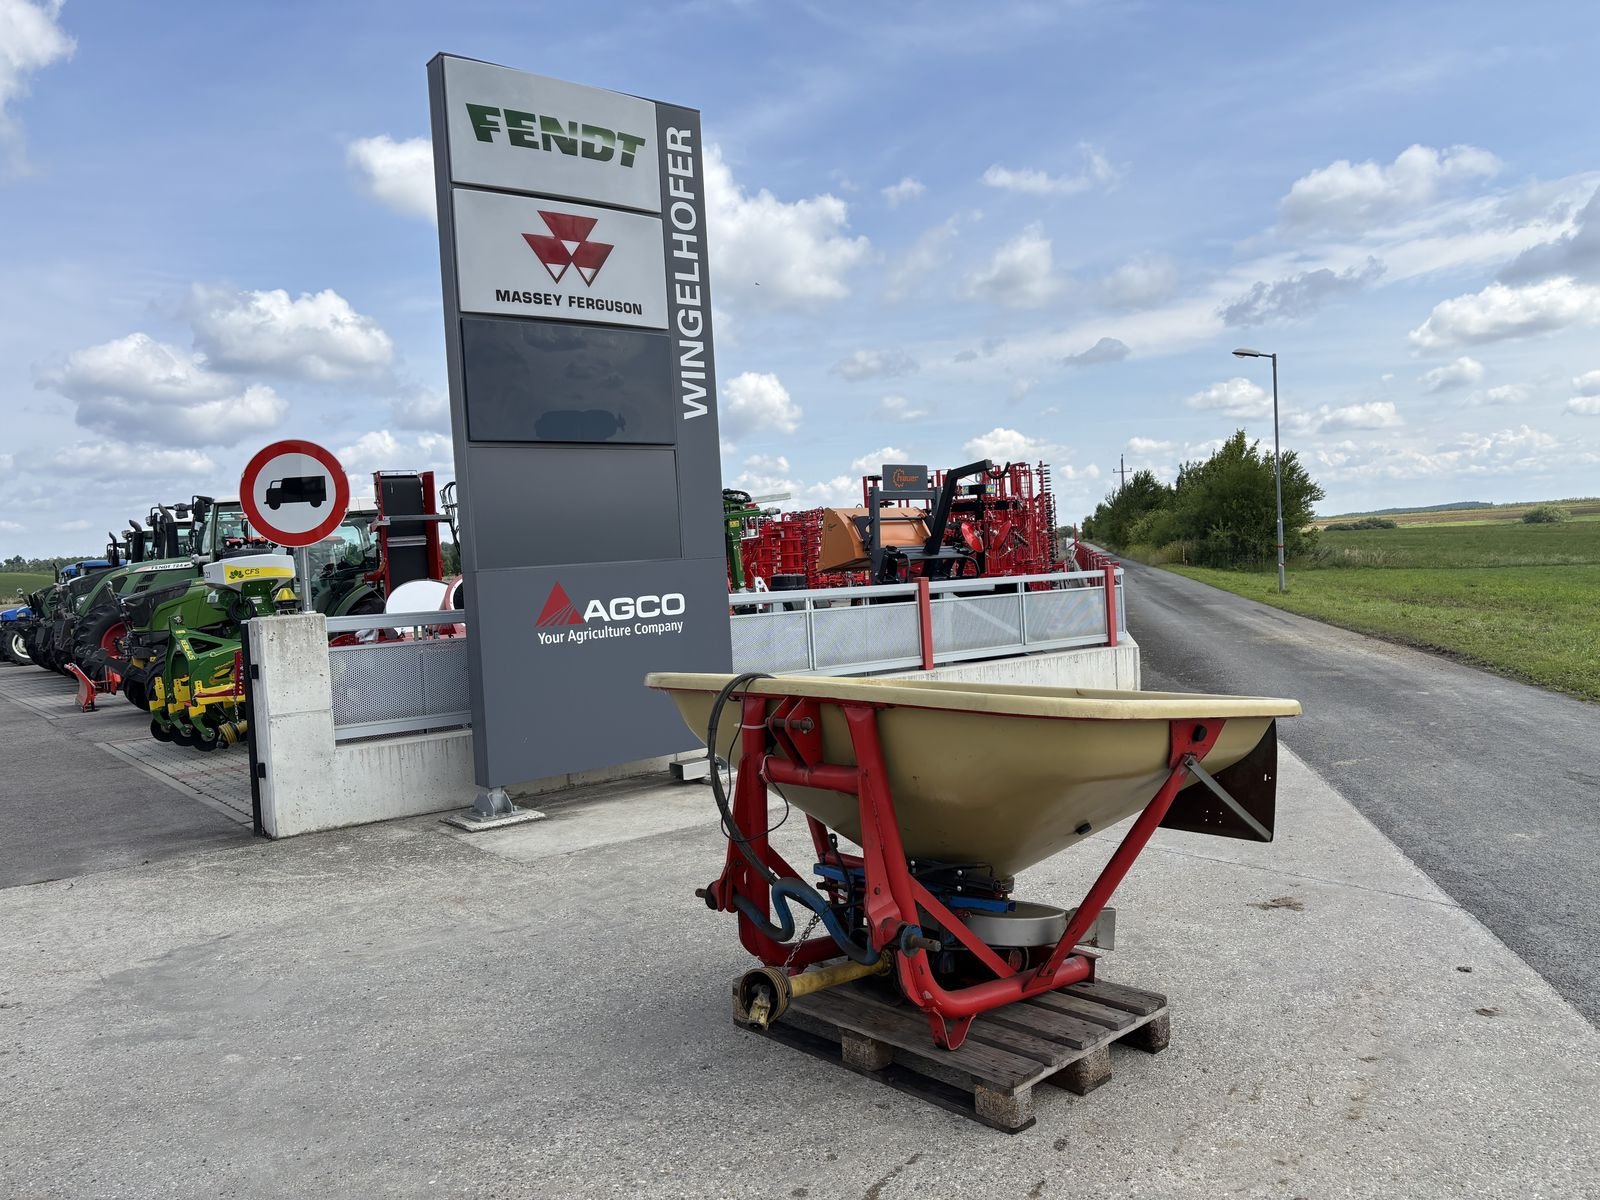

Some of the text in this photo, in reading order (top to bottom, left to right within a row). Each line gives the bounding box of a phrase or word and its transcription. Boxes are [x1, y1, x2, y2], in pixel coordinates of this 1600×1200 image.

[466, 103, 646, 168] FENDT
[666, 126, 708, 420] WINGELHOFER
[495, 289, 643, 315] MASSEY FERGUSON
[244, 567, 260, 576] CFS
[583, 593, 685, 623] AGCO
[537, 621, 684, 645] Your Agriculture Company
